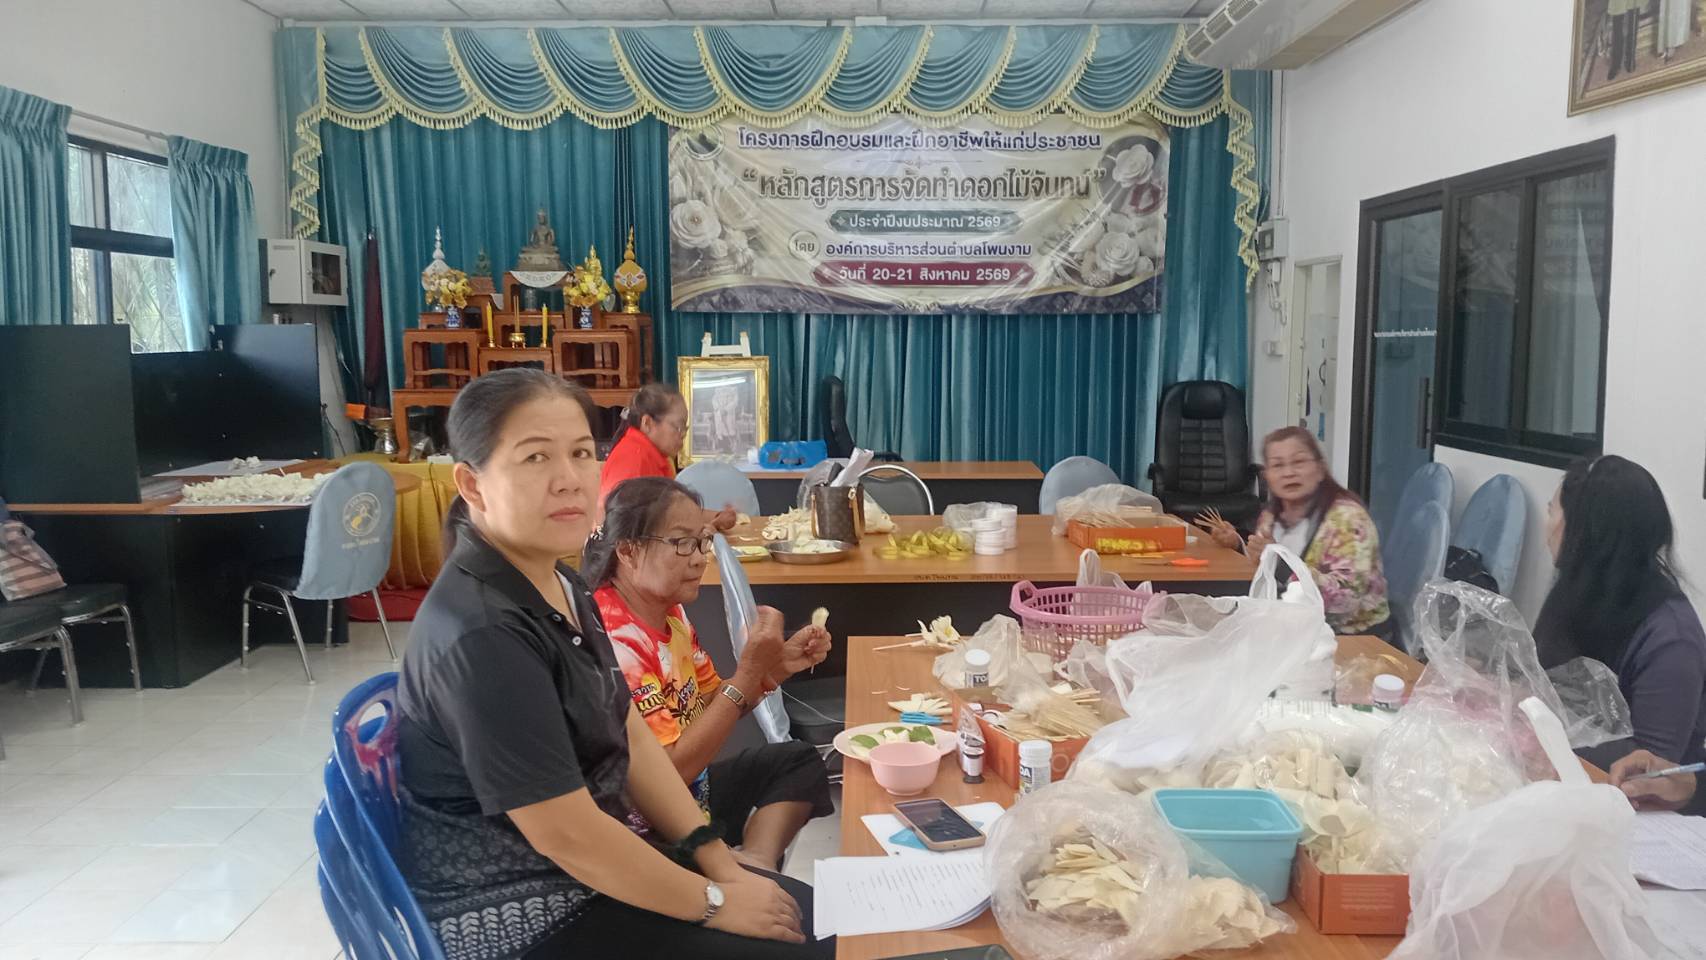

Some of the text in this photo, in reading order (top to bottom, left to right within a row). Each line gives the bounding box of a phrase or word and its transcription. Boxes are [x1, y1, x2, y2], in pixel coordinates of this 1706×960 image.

[738, 127, 1101, 149] โครงการฝึกอบรมและฝึกอาชีพให้แก่ประชาชน
[849, 214, 1001, 228] ประจำปีงบประมาณ 2569
[794, 239, 1032, 256] โดย องค์การบริหารส่วนตำบลโพนงาม
[839, 264, 1011, 281] วันที่ 20-21 สิงหาคม 2569
